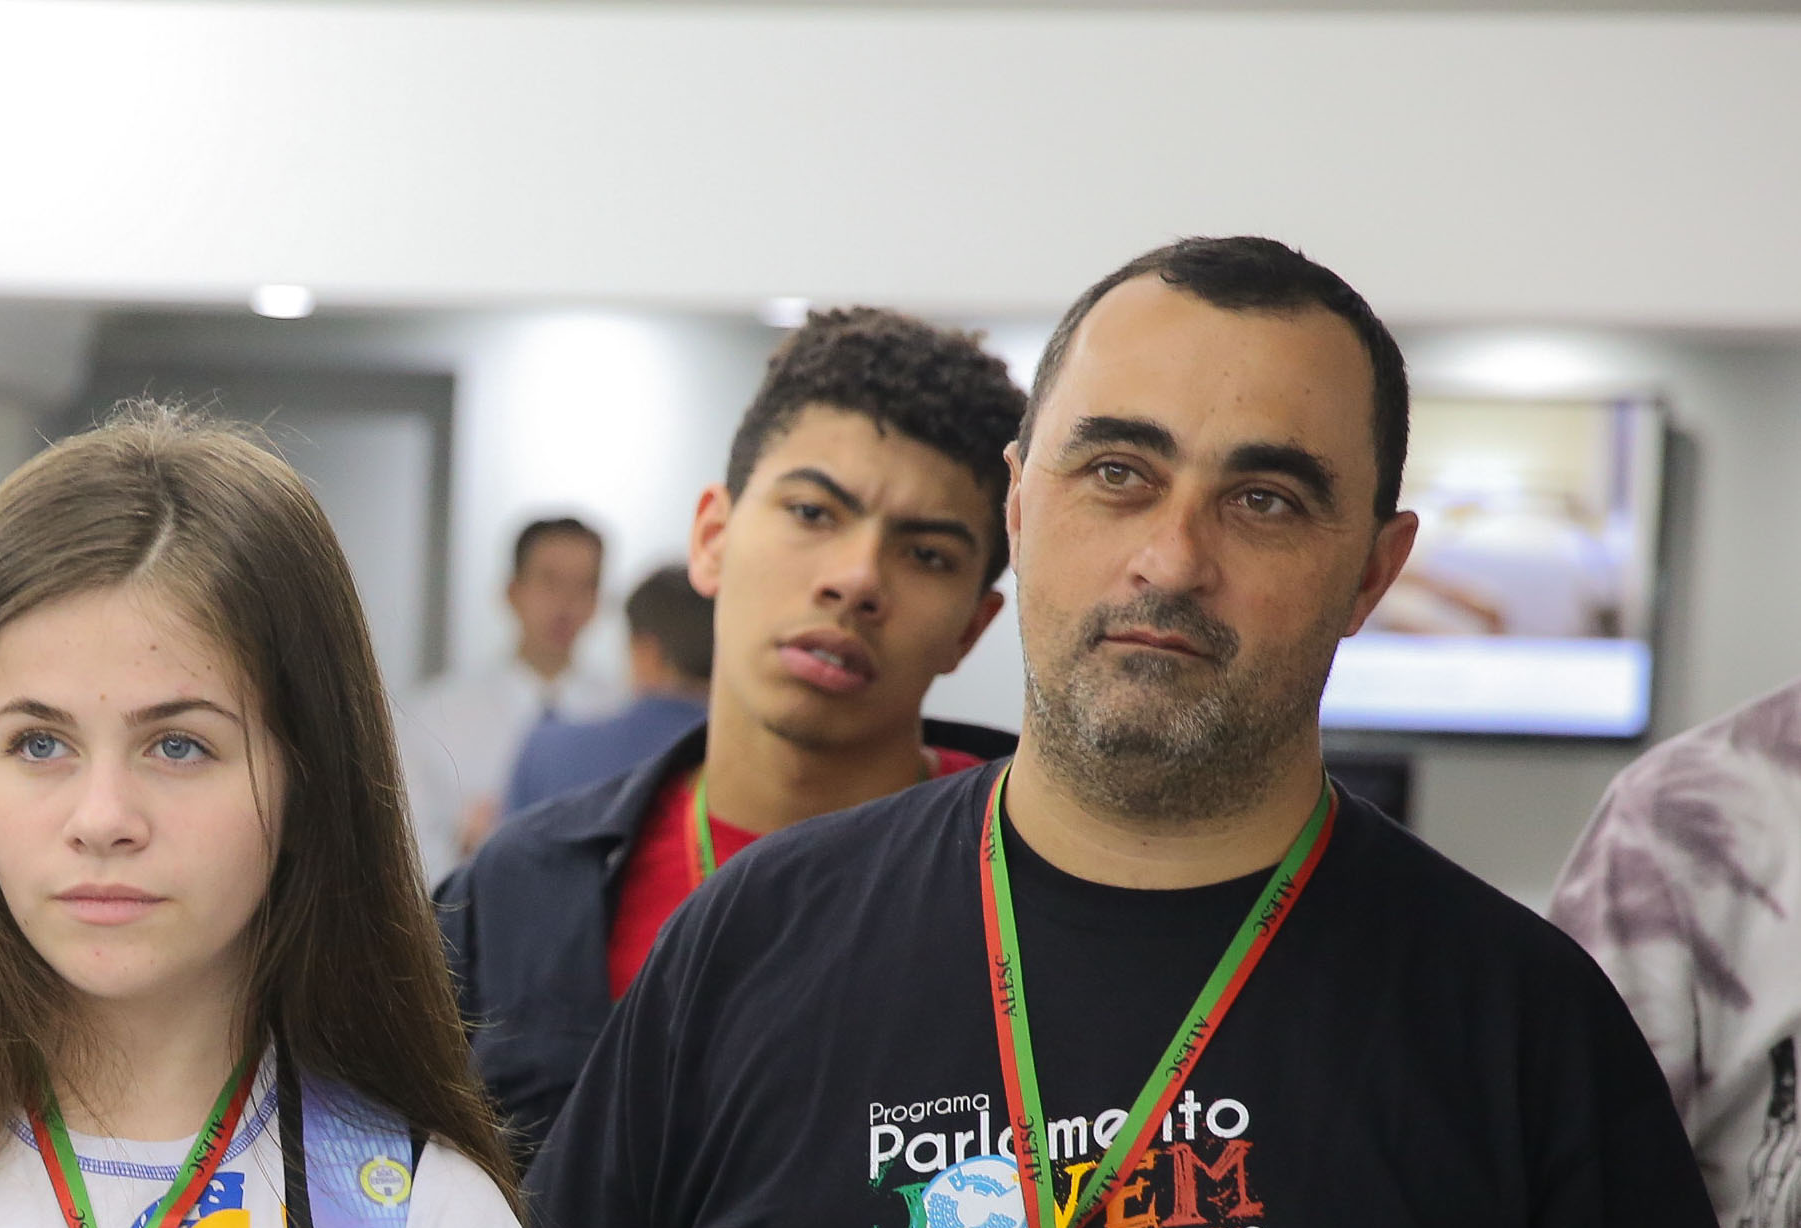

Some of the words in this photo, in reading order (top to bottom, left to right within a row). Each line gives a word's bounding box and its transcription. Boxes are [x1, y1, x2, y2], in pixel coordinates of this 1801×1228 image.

[1253, 874, 1297, 937] ALESC
[995, 952, 1018, 1018] ALESC
[1166, 1016, 1211, 1083] ALESC
[869, 1092, 990, 1125] Programa
[187, 1113, 227, 1178] ALESC
[1017, 1115, 1044, 1186] ALESC
